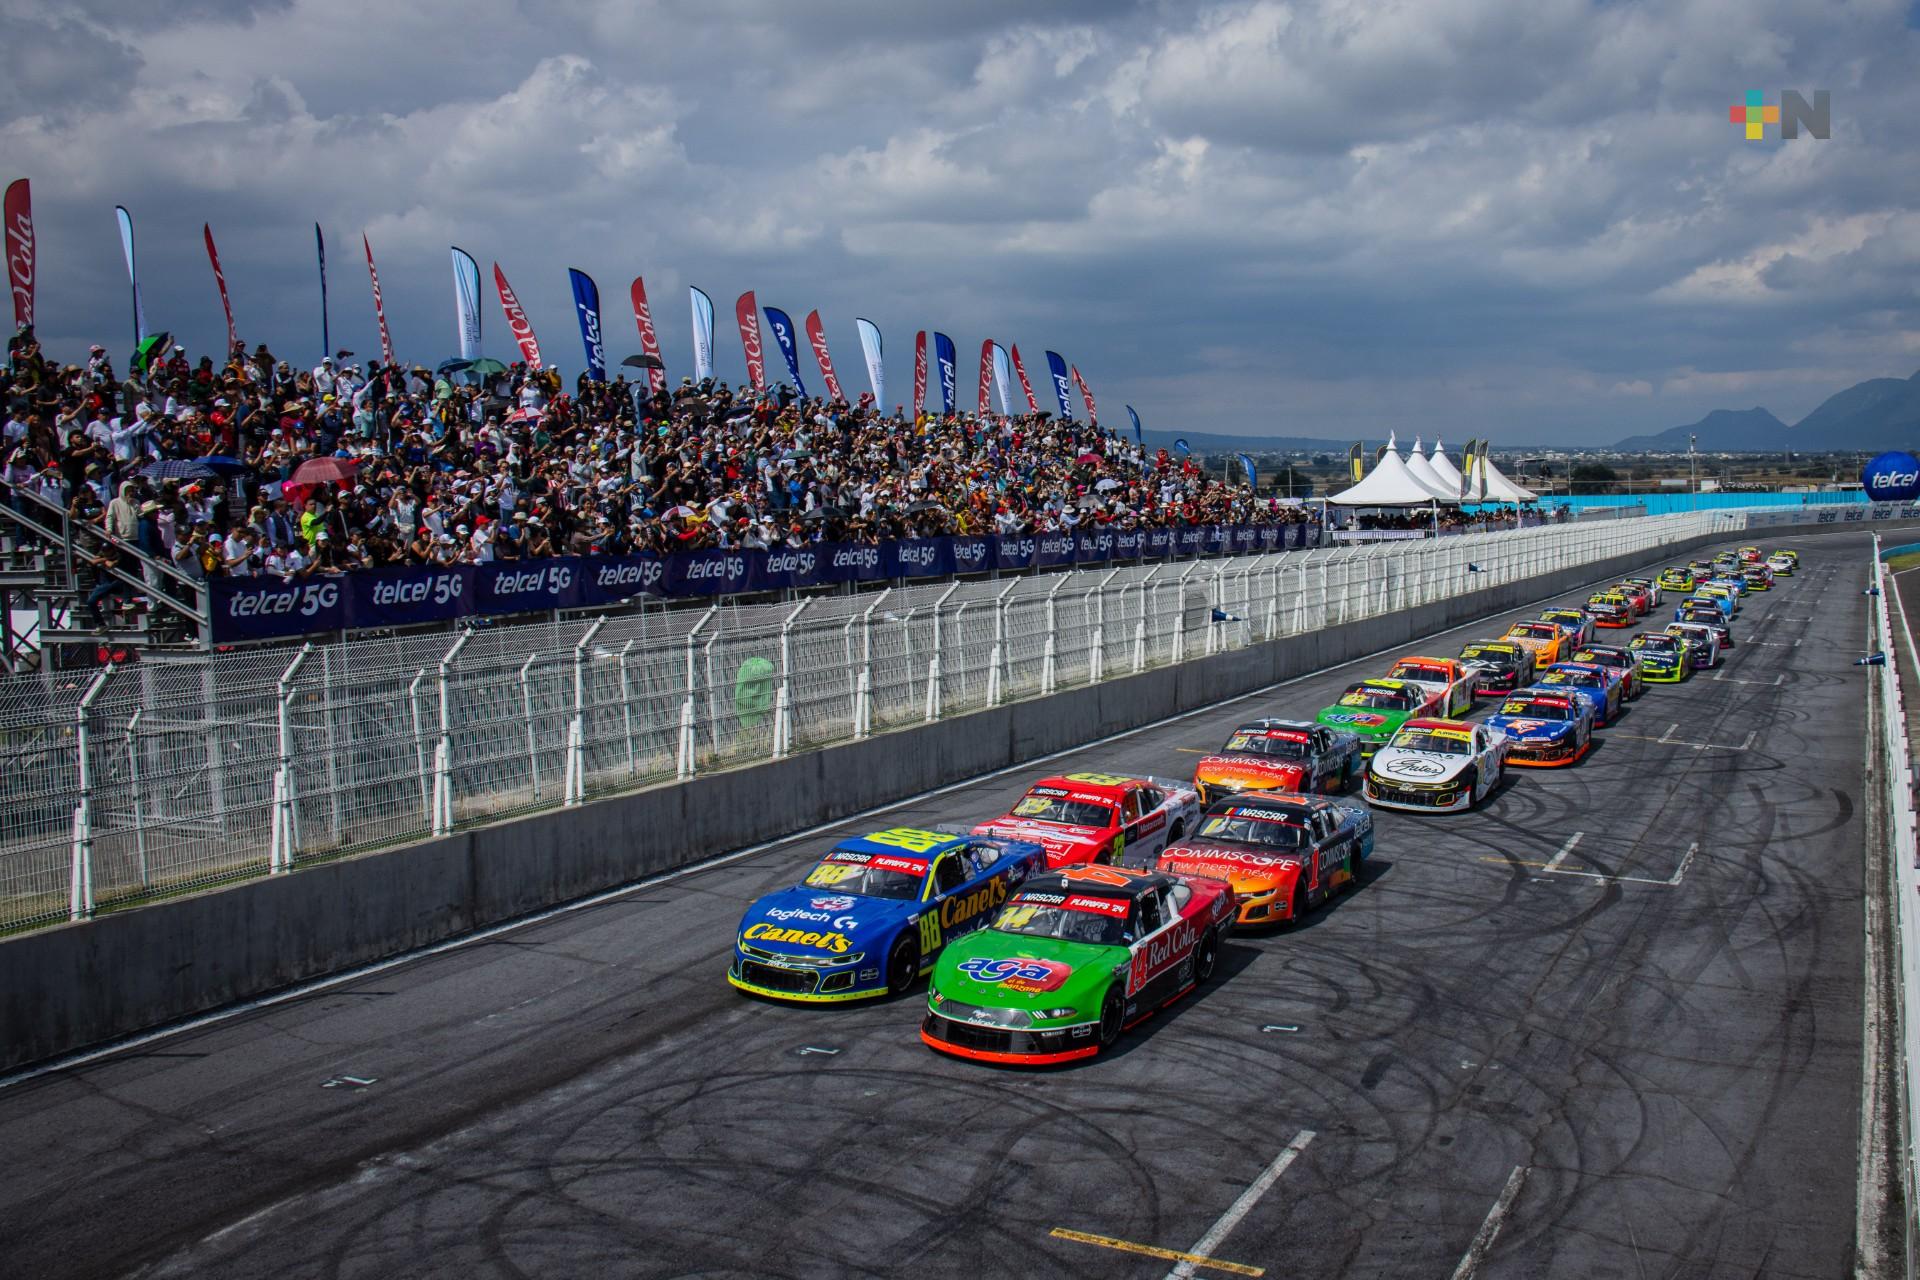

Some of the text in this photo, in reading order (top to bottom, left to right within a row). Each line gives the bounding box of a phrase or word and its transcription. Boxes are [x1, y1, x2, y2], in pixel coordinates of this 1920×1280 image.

[9, 213, 33, 286] Cola
[501, 287, 530, 334] Cola
[635, 302, 657, 350] Cola
[741, 313, 761, 357] Cola
[812, 331, 832, 371] Cola
[914, 347, 927, 414] Red Cola
[982, 353, 993, 387] Cola
[1872, 470, 1919, 489] telcel
[972, 543, 985, 562] 5G
[1001, 539, 1034, 558] telcel 5G
[1041, 538, 1074, 555] telcel 5G
[1100, 534, 1112, 551] 5G
[1118, 535, 1135, 548] telcel
[766, 553, 816, 574] telcel 5G
[833, 549, 878, 568] telcel 5G
[899, 546, 934, 566] telcel 5G
[597, 562, 662, 586] telcel 5G
[686, 557, 744, 581] telcel 5G
[373, 574, 462, 605] telcel 5G
[494, 567, 571, 595] telcel 5G
[230, 583, 338, 617] telcel 5G
[1200, 756, 1297, 774] COMMSCOPE
[1225, 766, 1258, 775] meets
[1260, 771, 1284, 781] next
[1239, 808, 1288, 822] NASCAR
[864, 827, 959, 853] 88
[835, 853, 872, 863] NASCAR
[875, 858, 911, 868] PLAYOFFS
[1162, 847, 1296, 871] COMMSCOPE
[1308, 848, 1319, 892] 1
[806, 864, 850, 884] 88
[1196, 862, 1239, 873] meets
[1242, 868, 1273, 880] next
[942, 875, 1007, 929] Canel's
[1023, 893, 1066, 904] NASCAR
[1070, 898, 1110, 910] PLAYOFFS
[766, 907, 831, 922] logitech
[993, 907, 1038, 928] 14
[743, 923, 854, 953] Canel's
[920, 909, 941, 956] 88
[1149, 919, 1199, 969] Red Cola
[957, 957, 1052, 982] aga
[997, 983, 1043, 993] manzana
[967, 1017, 996, 1026] telcel
